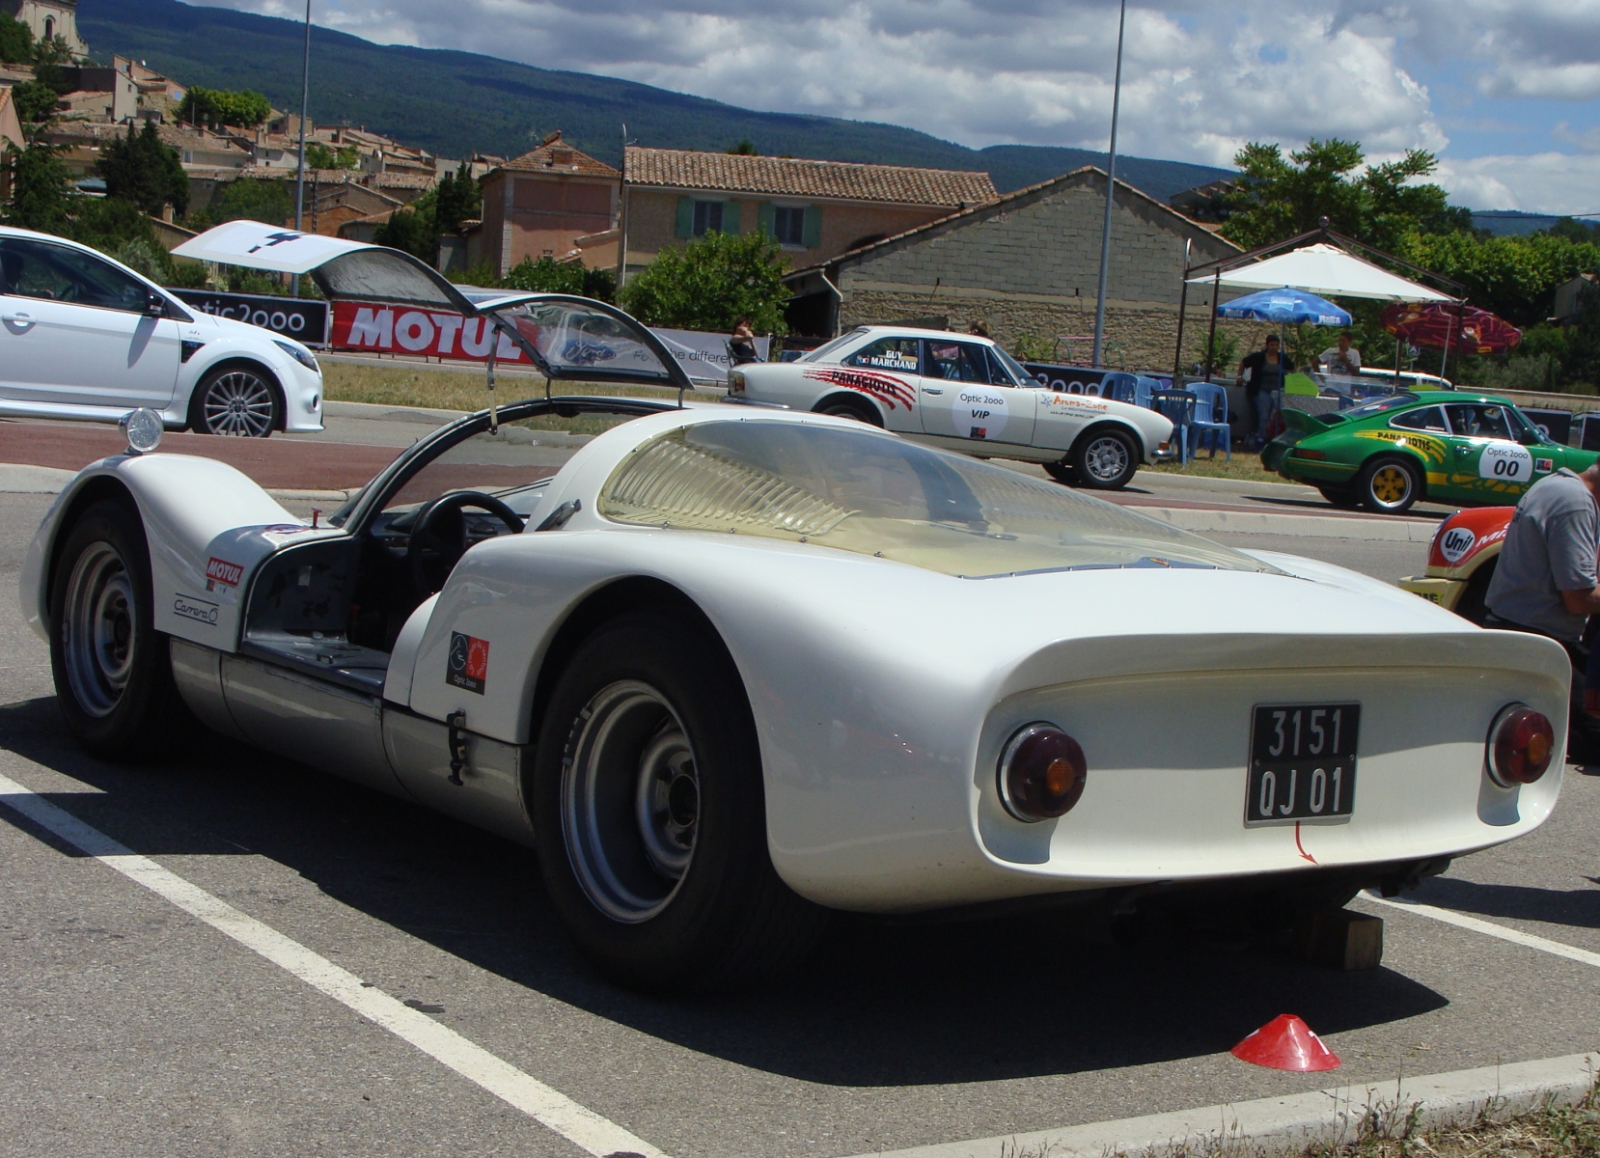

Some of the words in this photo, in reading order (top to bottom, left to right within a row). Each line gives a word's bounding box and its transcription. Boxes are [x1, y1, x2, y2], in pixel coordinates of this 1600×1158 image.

[347, 307, 522, 360] MOTUL
[870, 356, 917, 370] MARCHAND
[886, 350, 903, 360] GUY
[831, 371, 897, 395] PANAGIOTIS
[960, 393, 982, 404] Optic
[984, 395, 1004, 405] 2000
[971, 409, 991, 420] VIP
[1377, 431, 1431, 451] PANAIOTIS
[1487, 447, 1508, 458] Optic
[1510, 450, 1528, 459] 2000
[1494, 459, 1519, 477] 00
[1445, 531, 1474, 552] Unil
[207, 560, 241, 584] MOTUL
[174, 599, 209, 620] Carrera
[1268, 708, 1342, 757] 3151
[1260, 769, 1297, 817] QJ
[1309, 766, 1342, 814] 01
